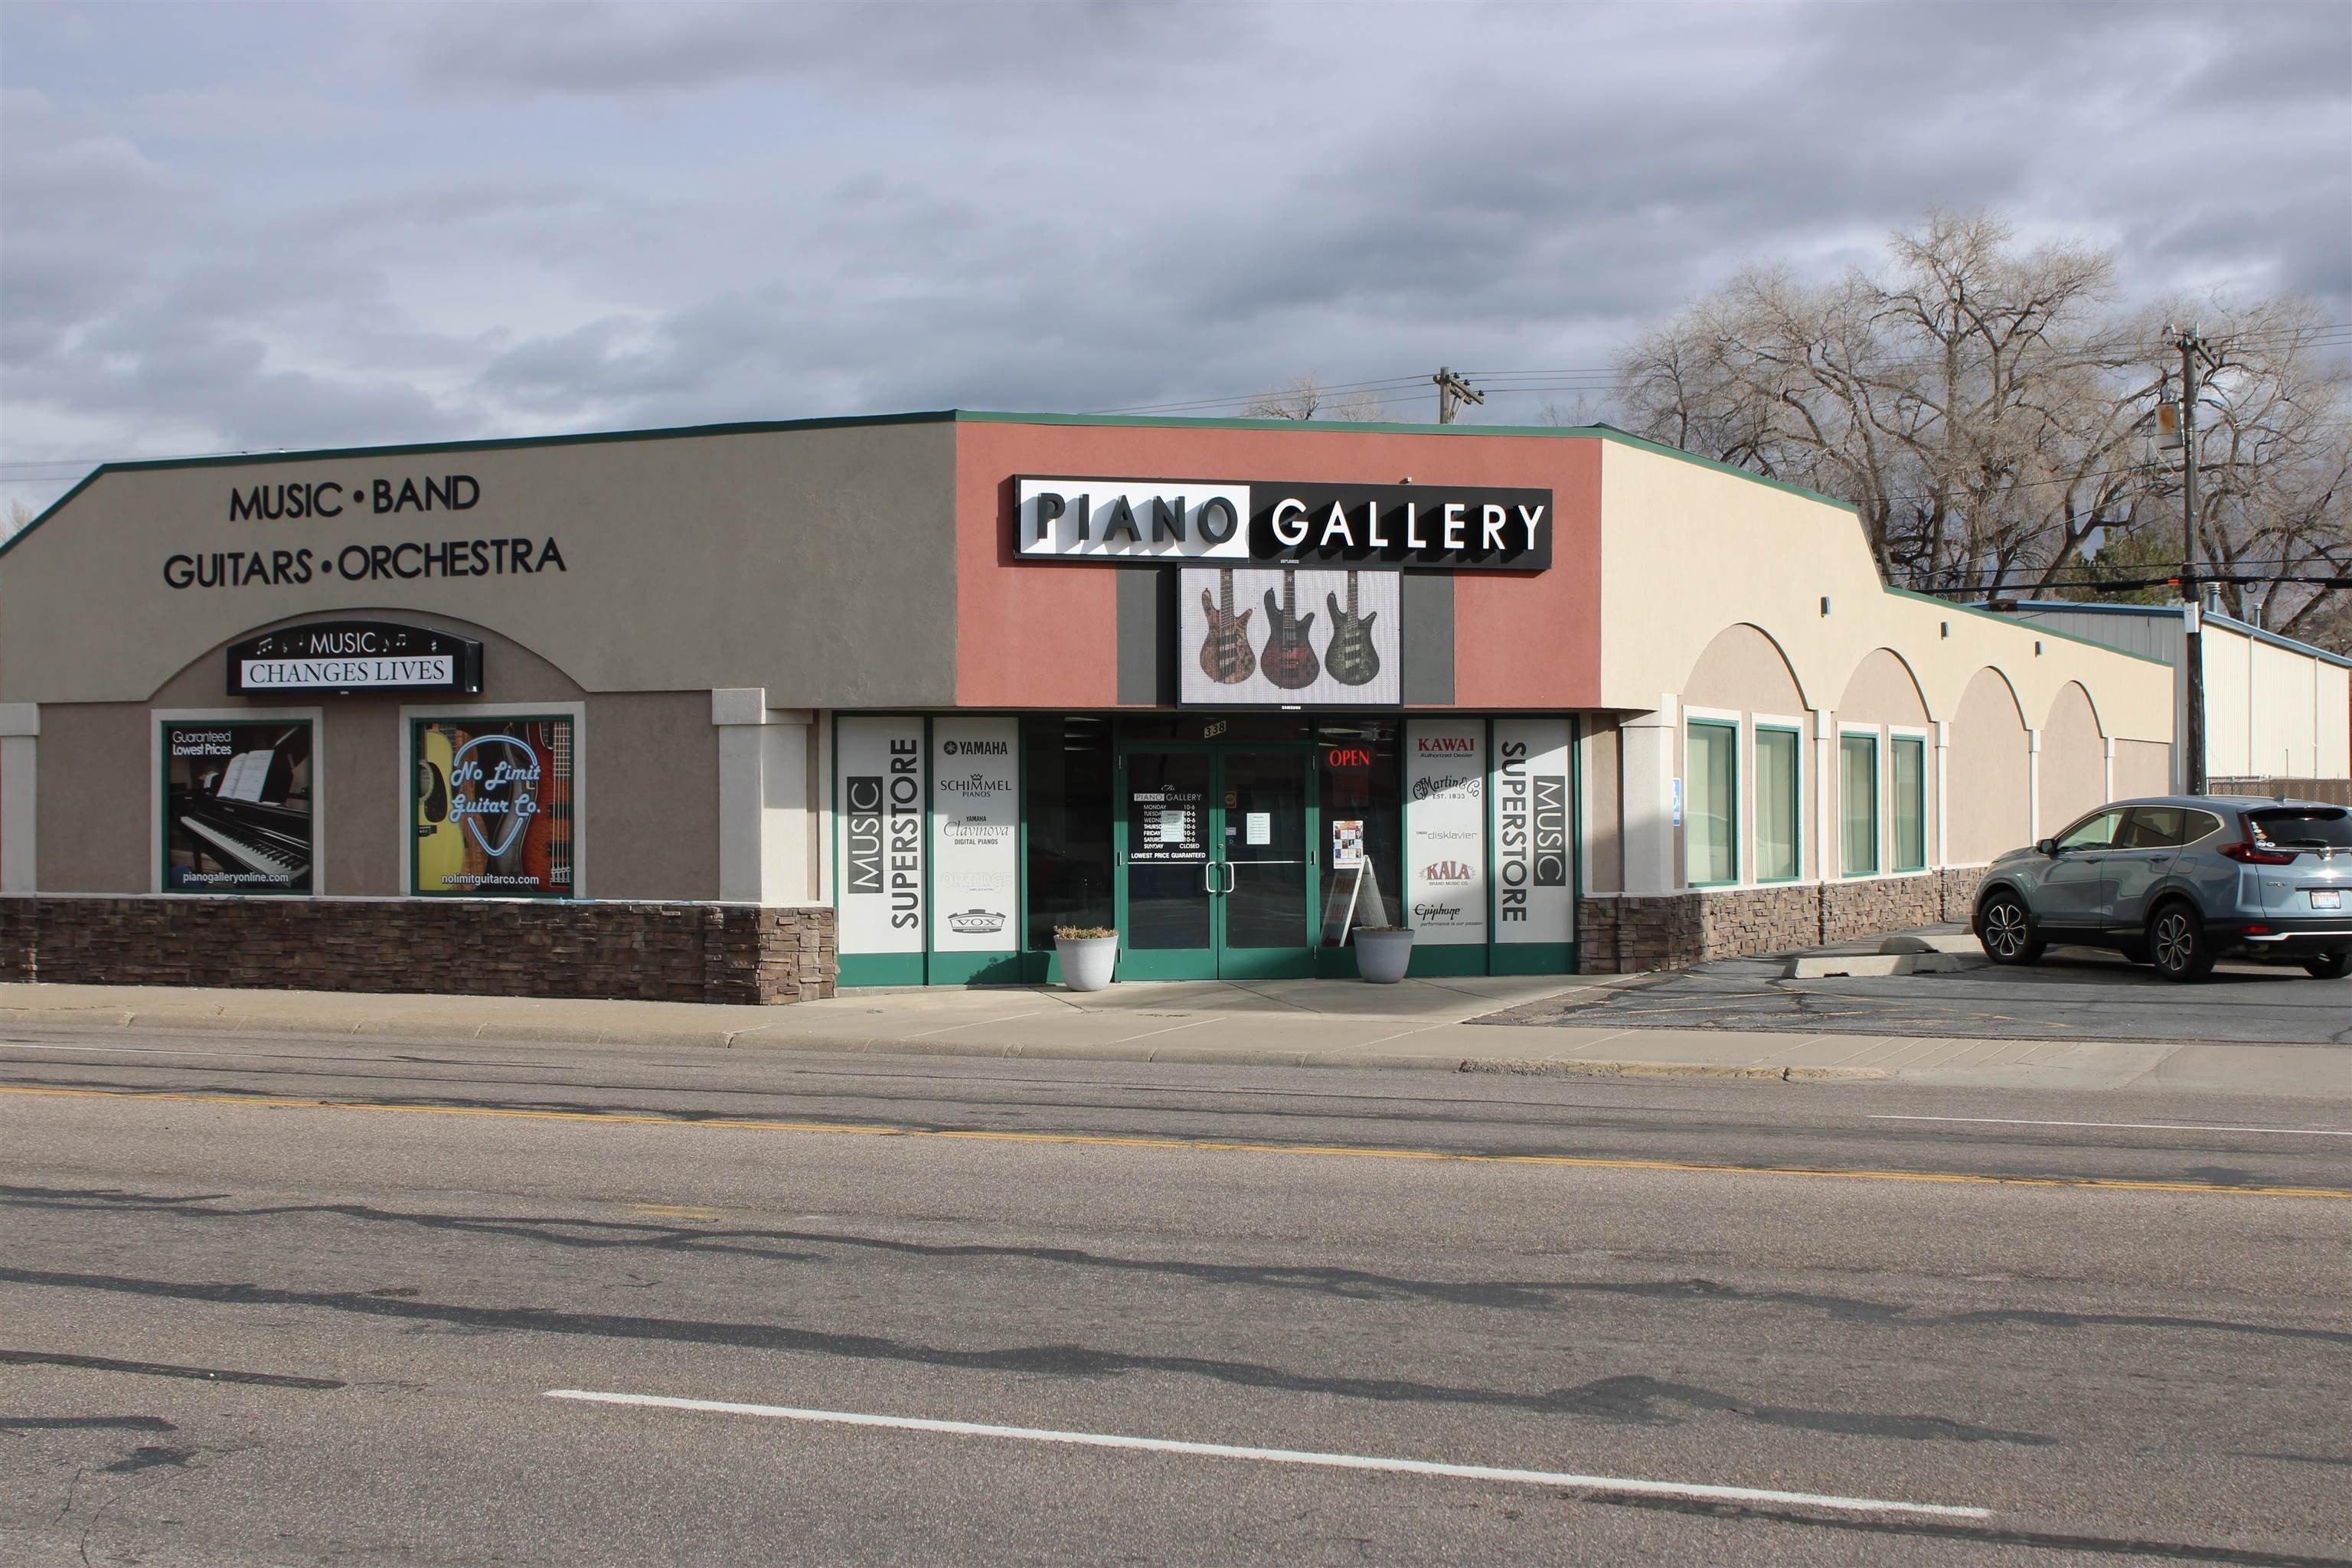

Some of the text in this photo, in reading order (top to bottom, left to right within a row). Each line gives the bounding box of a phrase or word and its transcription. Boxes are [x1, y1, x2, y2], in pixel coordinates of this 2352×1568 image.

[230, 475, 480, 521] MUSIC BAND
[1037, 492, 1545, 550] PIANO GALLERY
[163, 537, 567, 589] GUITARS ORCHESTRA
[310, 632, 376, 655] MUSIC
[250, 659, 446, 684] CHANGES LIVES
[172, 730, 231, 743] Guaranteed
[1205, 722, 1225, 737] 338
[172, 743, 232, 756] Lowest Prices
[959, 741, 1008, 755] YAMAHA
[1418, 738, 1475, 751] KAWAI
[1329, 749, 1370, 767] OPEN
[451, 760, 541, 791] No Limit
[1424, 775, 1459, 792] Martin
[940, 780, 1012, 791] SCHIMMEL
[1165, 793, 1201, 802] GALLERY
[449, 793, 541, 822] Guitar Co.
[851, 782, 880, 888] MUSIC
[890, 739, 919, 929] SUPERSTORE
[943, 820, 1009, 837] Clavinova
[1427, 831, 1478, 839] disklavier
[1501, 740, 1527, 922] SUPERSTORE
[1536, 780, 1563, 881] MUSIC
[183, 871, 289, 884] pianogalleryonline.com
[1426, 861, 1472, 880] KALA
[442, 873, 540, 886] nolimitguitarco.com
[1413, 903, 1461, 920] Epiphone
